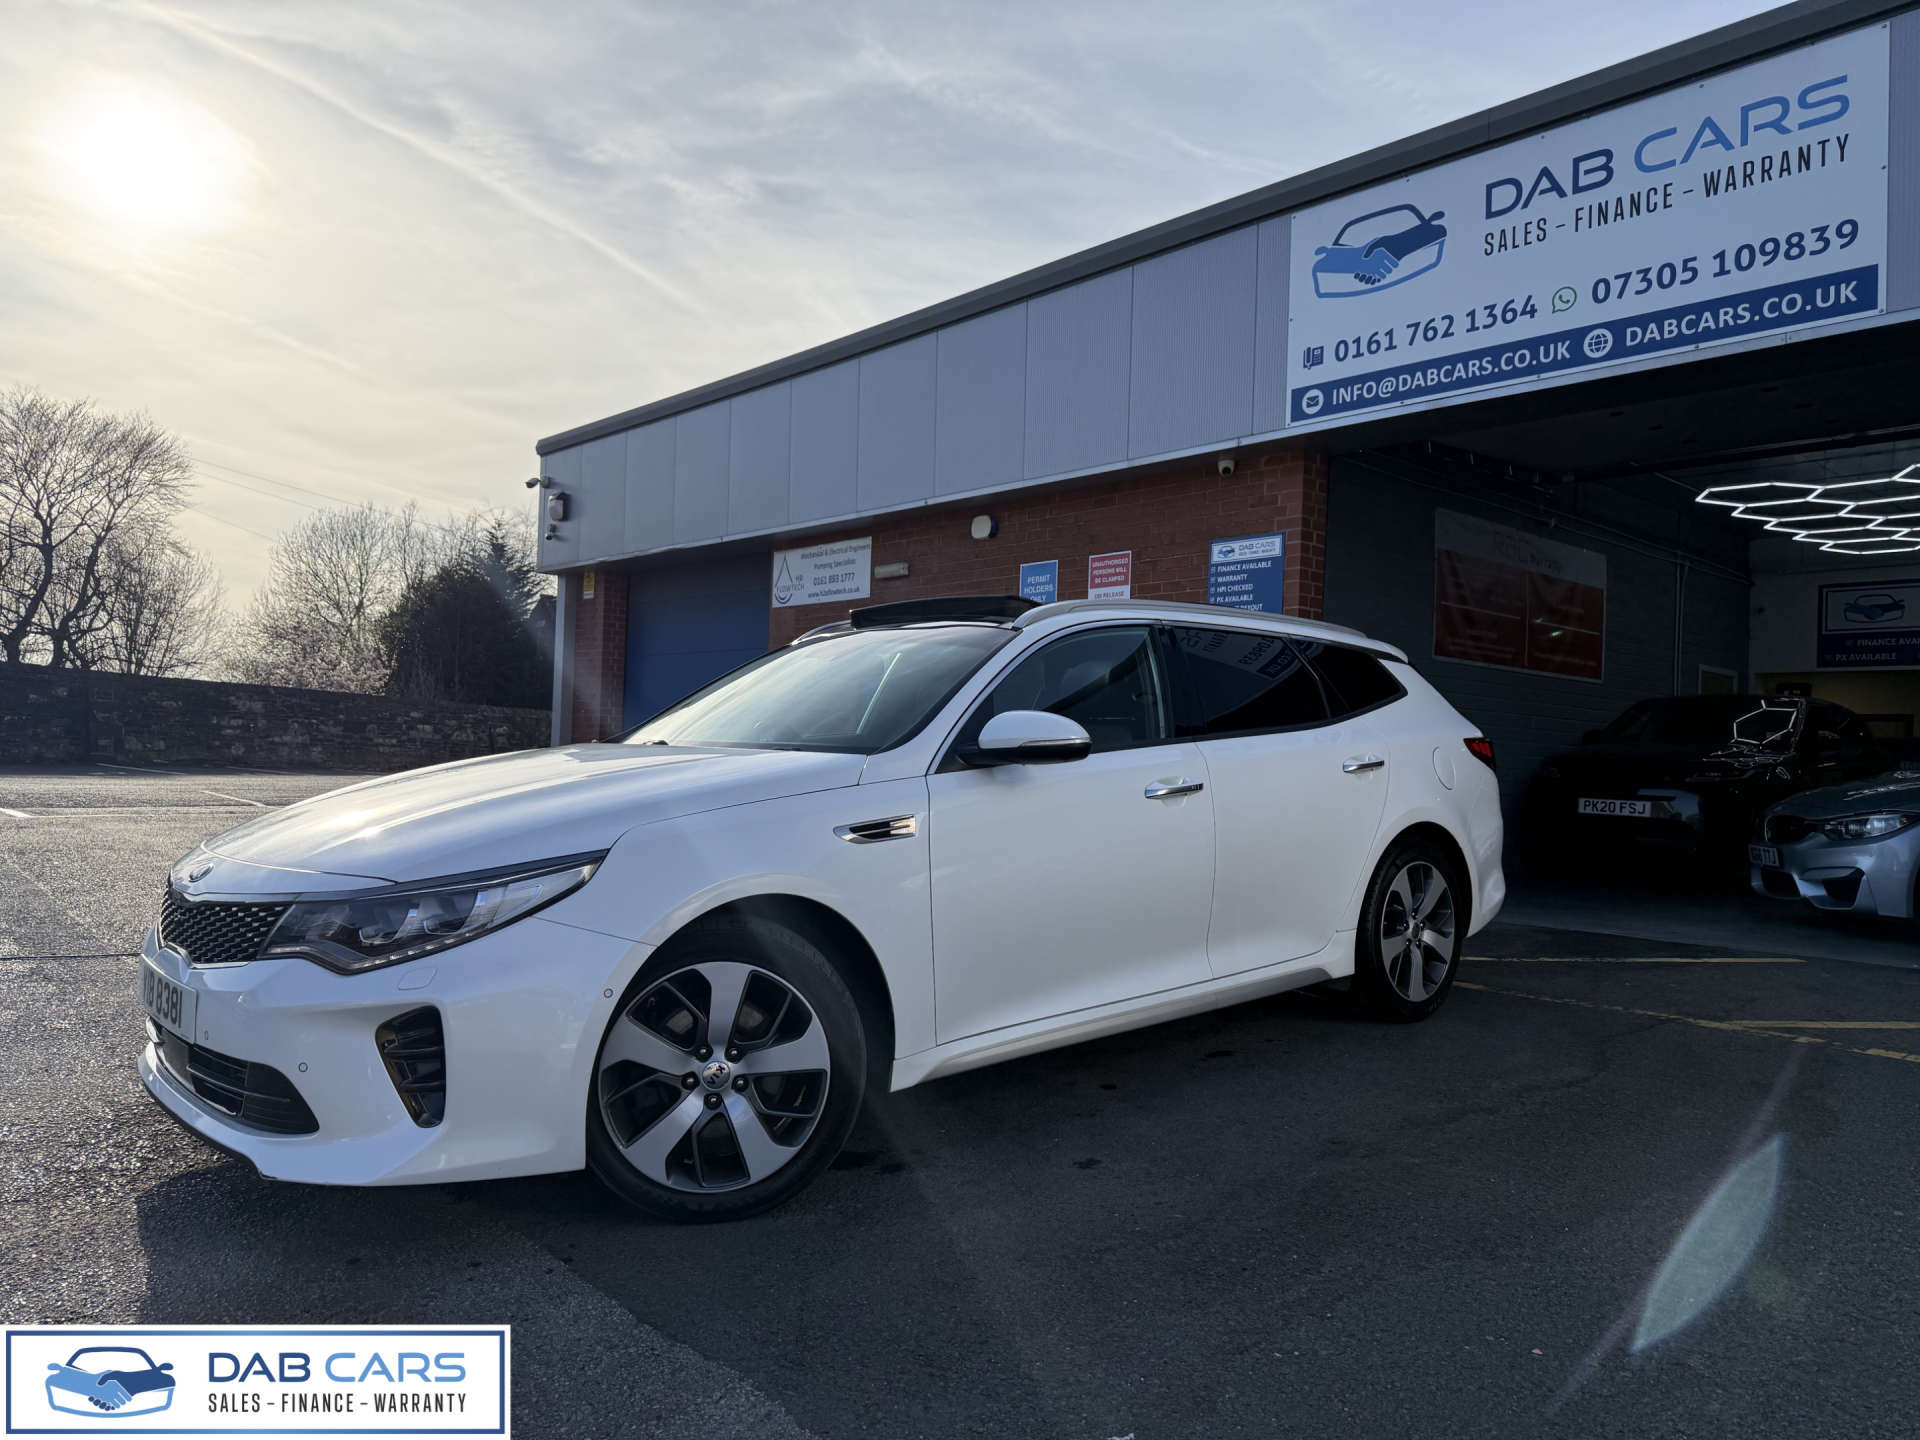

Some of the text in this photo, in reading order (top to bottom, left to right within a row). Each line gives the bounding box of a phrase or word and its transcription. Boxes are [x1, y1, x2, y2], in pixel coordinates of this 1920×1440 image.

[1485, 74, 1851, 220] DAB CARS
[1483, 218, 1548, 257] SALES
[1574, 182, 1673, 233] FINANCE
[1702, 133, 1850, 198] WARRANTY
[1334, 217, 1860, 363] 0161 762 1364 07305 109839
[1332, 280, 1859, 407] INFO@DABCARS.CO.UK DABCARS.CO.UK
[1217, 560, 1272, 572] FINANCE AVAILABLE
[1217, 574, 1248, 582] WARRANTY
[1023, 584, 1054, 594] HOLDERS
[1228, 583, 1254, 592] CHECKED
[1225, 594, 1253, 602] AVAILABLE
[1583, 800, 1646, 815] PK20 FSJ
